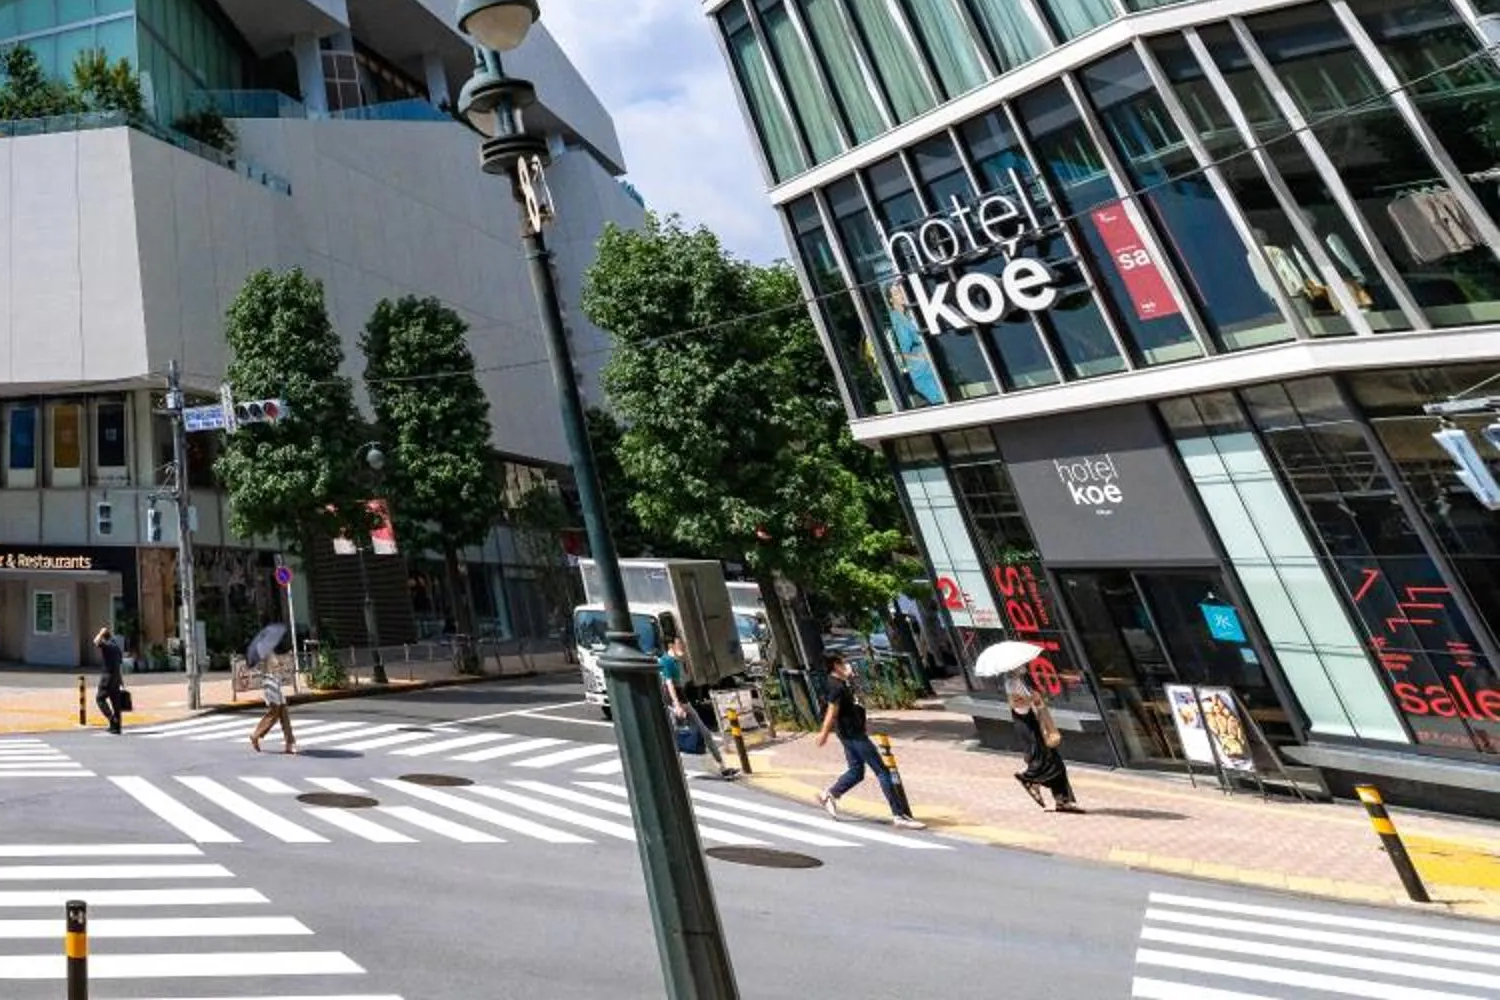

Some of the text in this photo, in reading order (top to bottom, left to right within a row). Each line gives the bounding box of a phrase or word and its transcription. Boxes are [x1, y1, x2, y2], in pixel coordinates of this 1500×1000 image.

[877, 167, 1043, 276] hotel
[1118, 249, 1151, 270] sa
[1053, 453, 1119, 482] hotel
[6, 553, 17, 569] &
[17, 553, 92, 569] Restaurants
